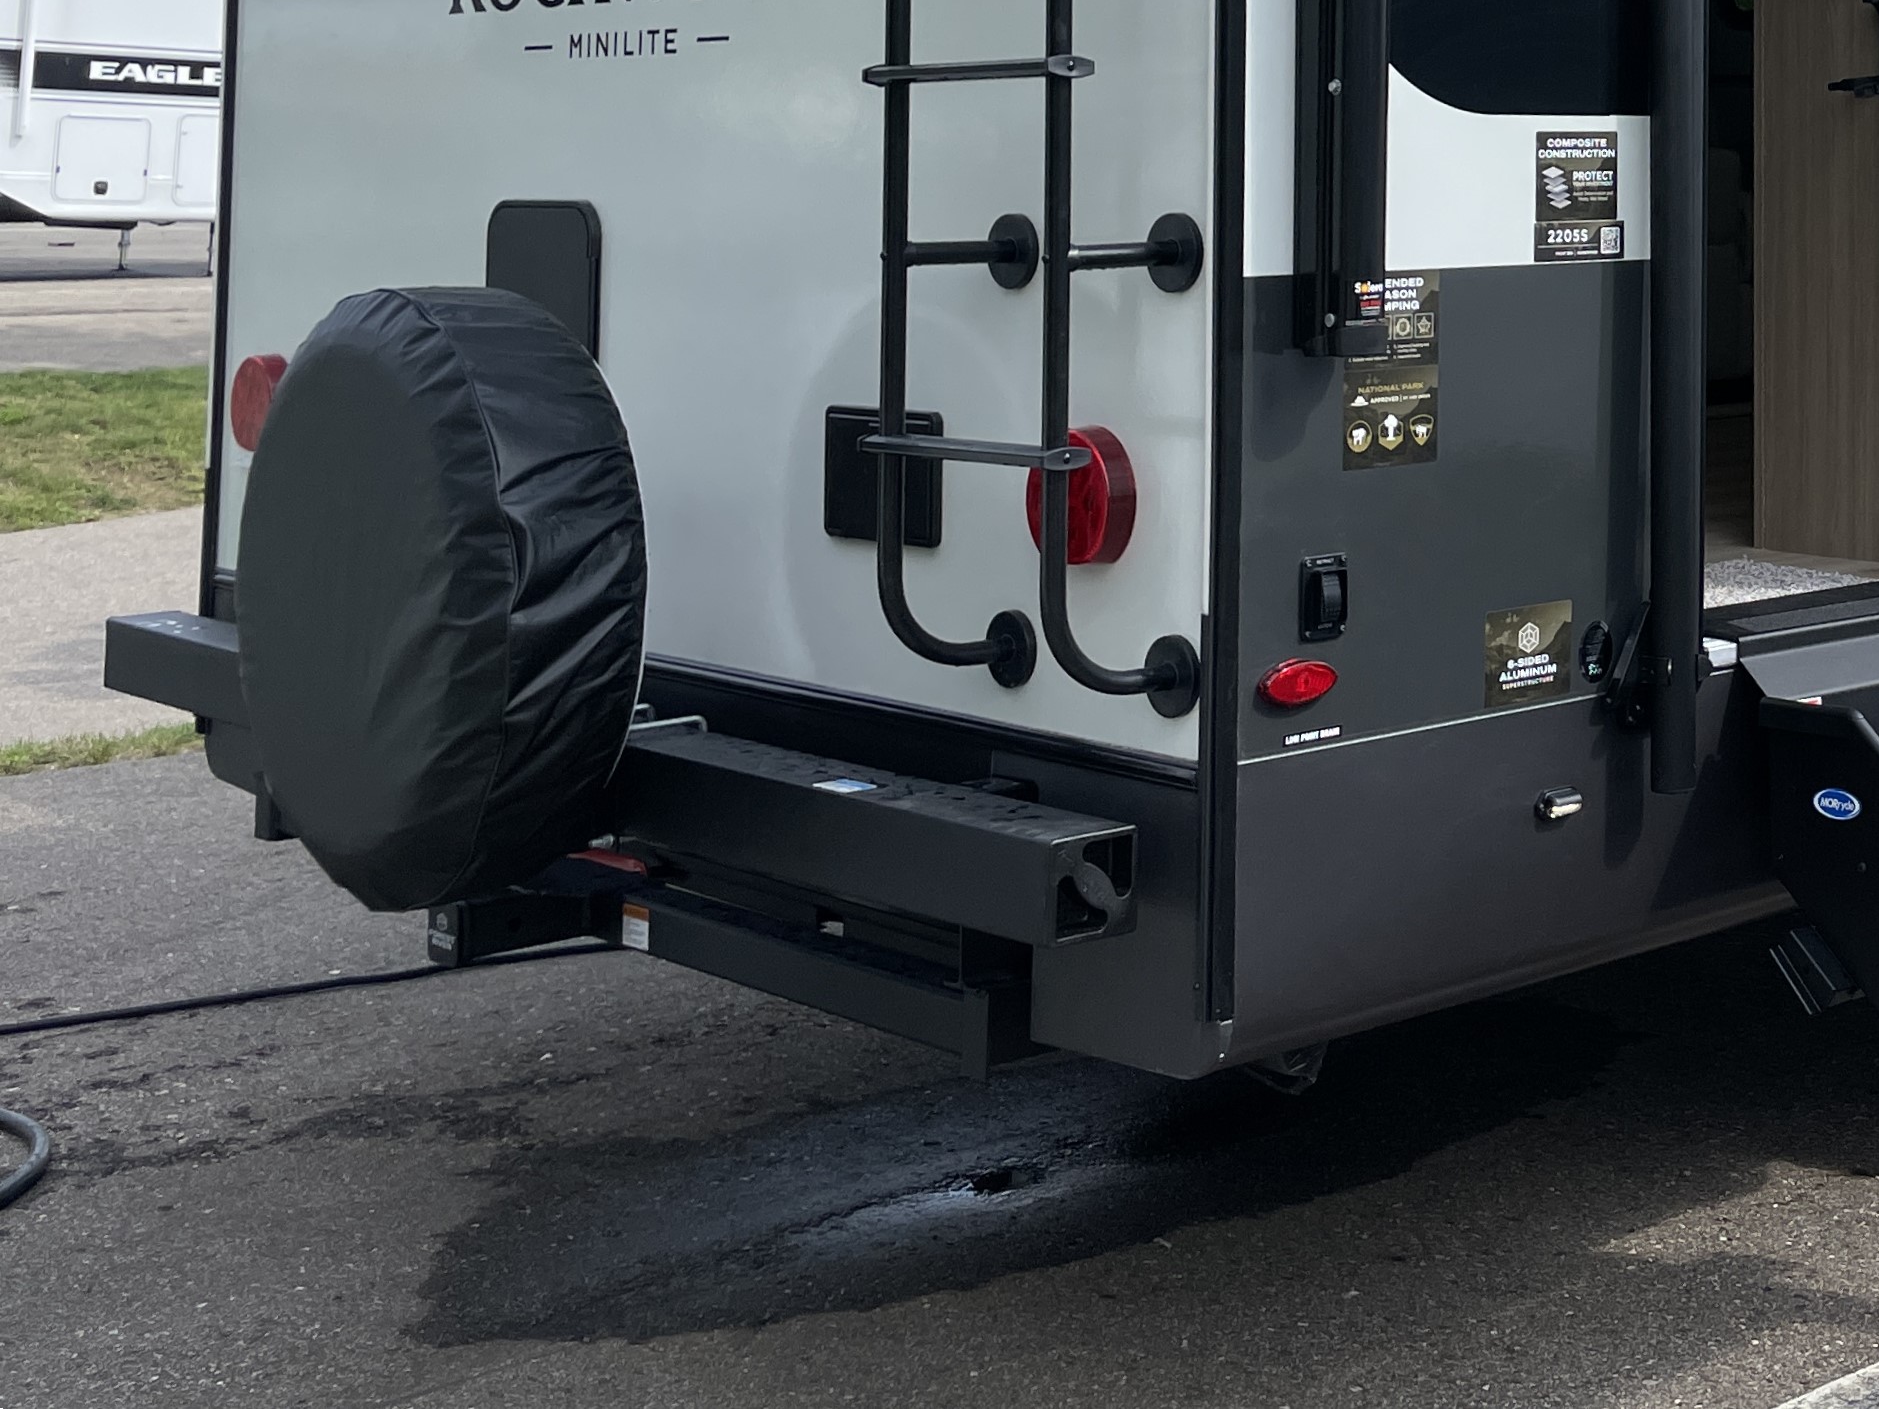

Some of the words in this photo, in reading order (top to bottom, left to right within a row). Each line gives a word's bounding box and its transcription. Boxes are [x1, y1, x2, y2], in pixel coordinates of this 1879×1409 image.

[570, 28, 677, 58] MINILITE
[1547, 138, 1607, 148] COMPOSITE
[1538, 149, 1615, 158] CONSTRUCTION
[1573, 171, 1613, 181] PROTECT
[1547, 228, 1588, 243] 2205S
[1384, 277, 1424, 288] ENDED
[1384, 289, 1417, 299] ASON
[1358, 384, 1400, 394] NATIONAL
[1401, 382, 1424, 390] PARK
[1507, 653, 1549, 670] 6-SIDED
[1499, 663, 1557, 683] ALUMINUM
[1502, 675, 1554, 690] SUPERSTRUCTURE
